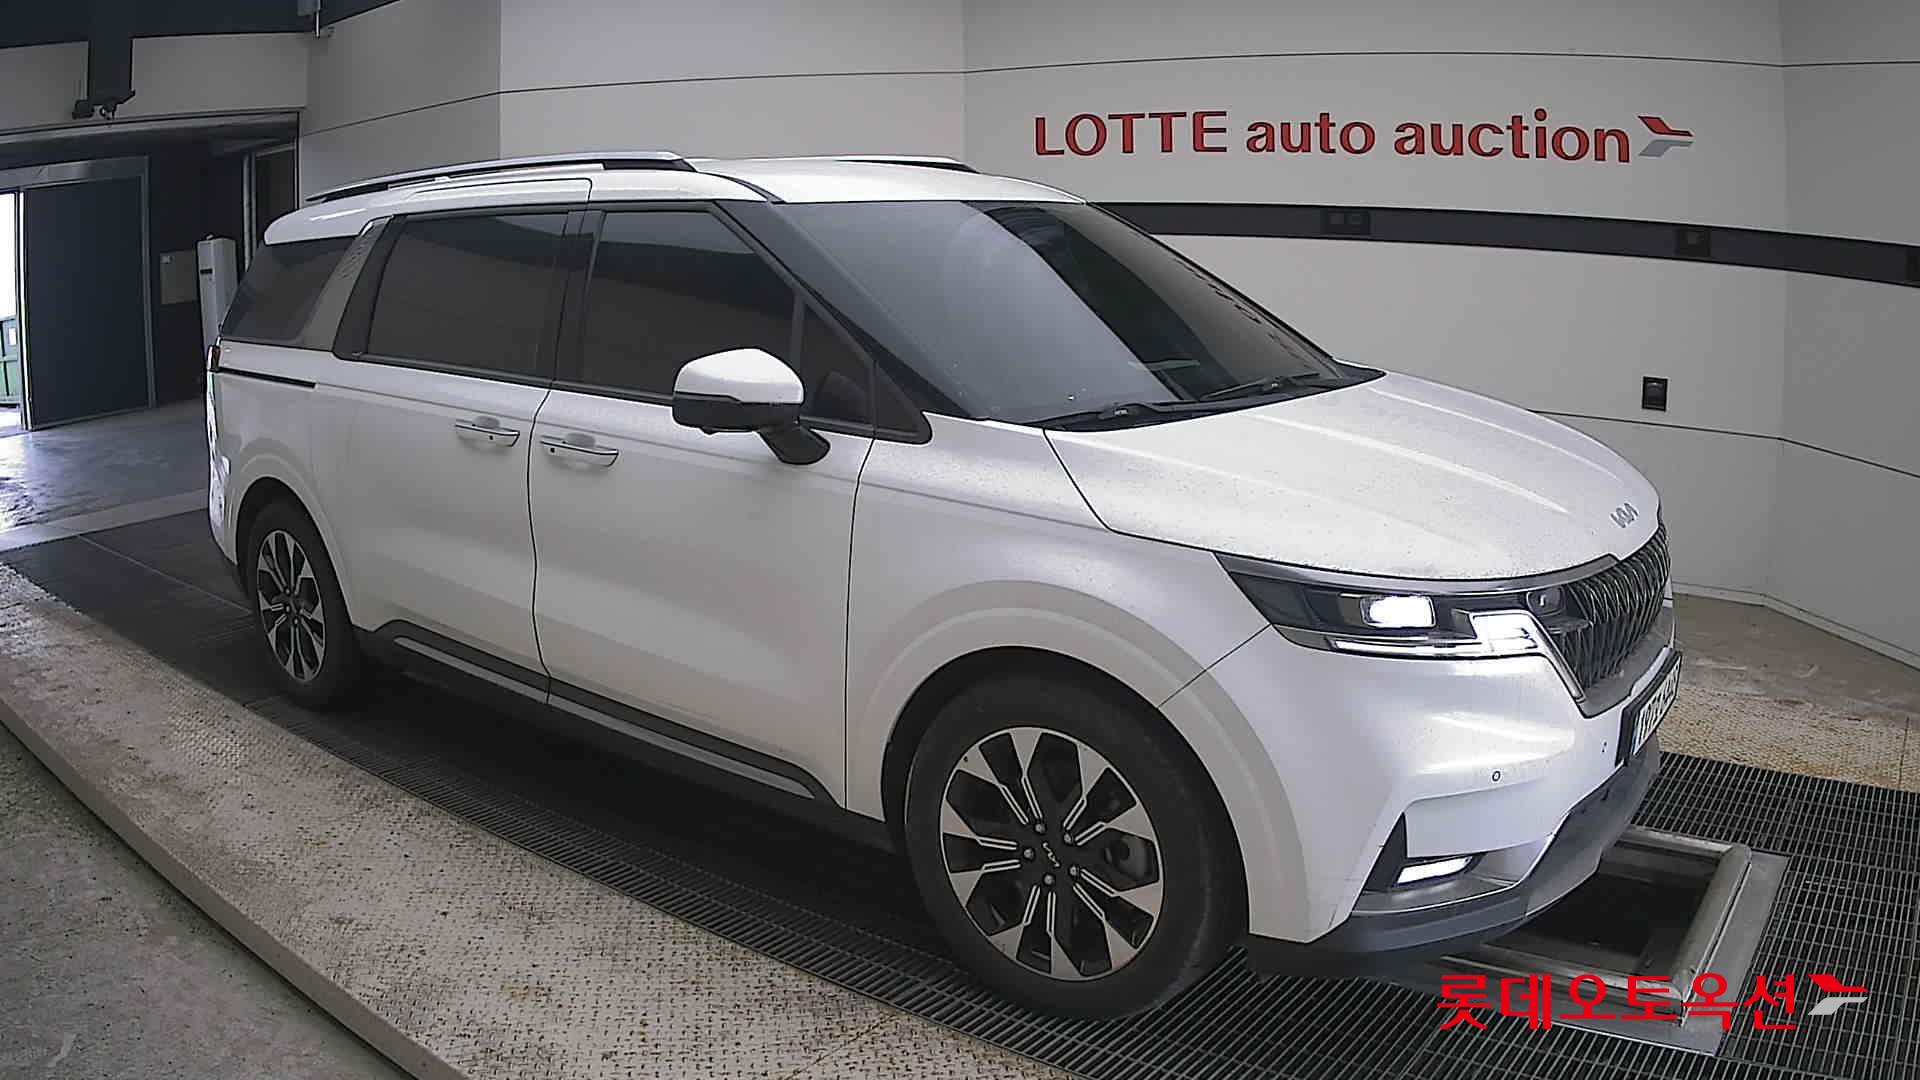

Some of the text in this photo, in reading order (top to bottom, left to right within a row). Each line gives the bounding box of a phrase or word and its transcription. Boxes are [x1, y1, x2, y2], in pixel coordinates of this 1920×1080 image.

[1034, 107, 1631, 163] LOTTE auto auction
